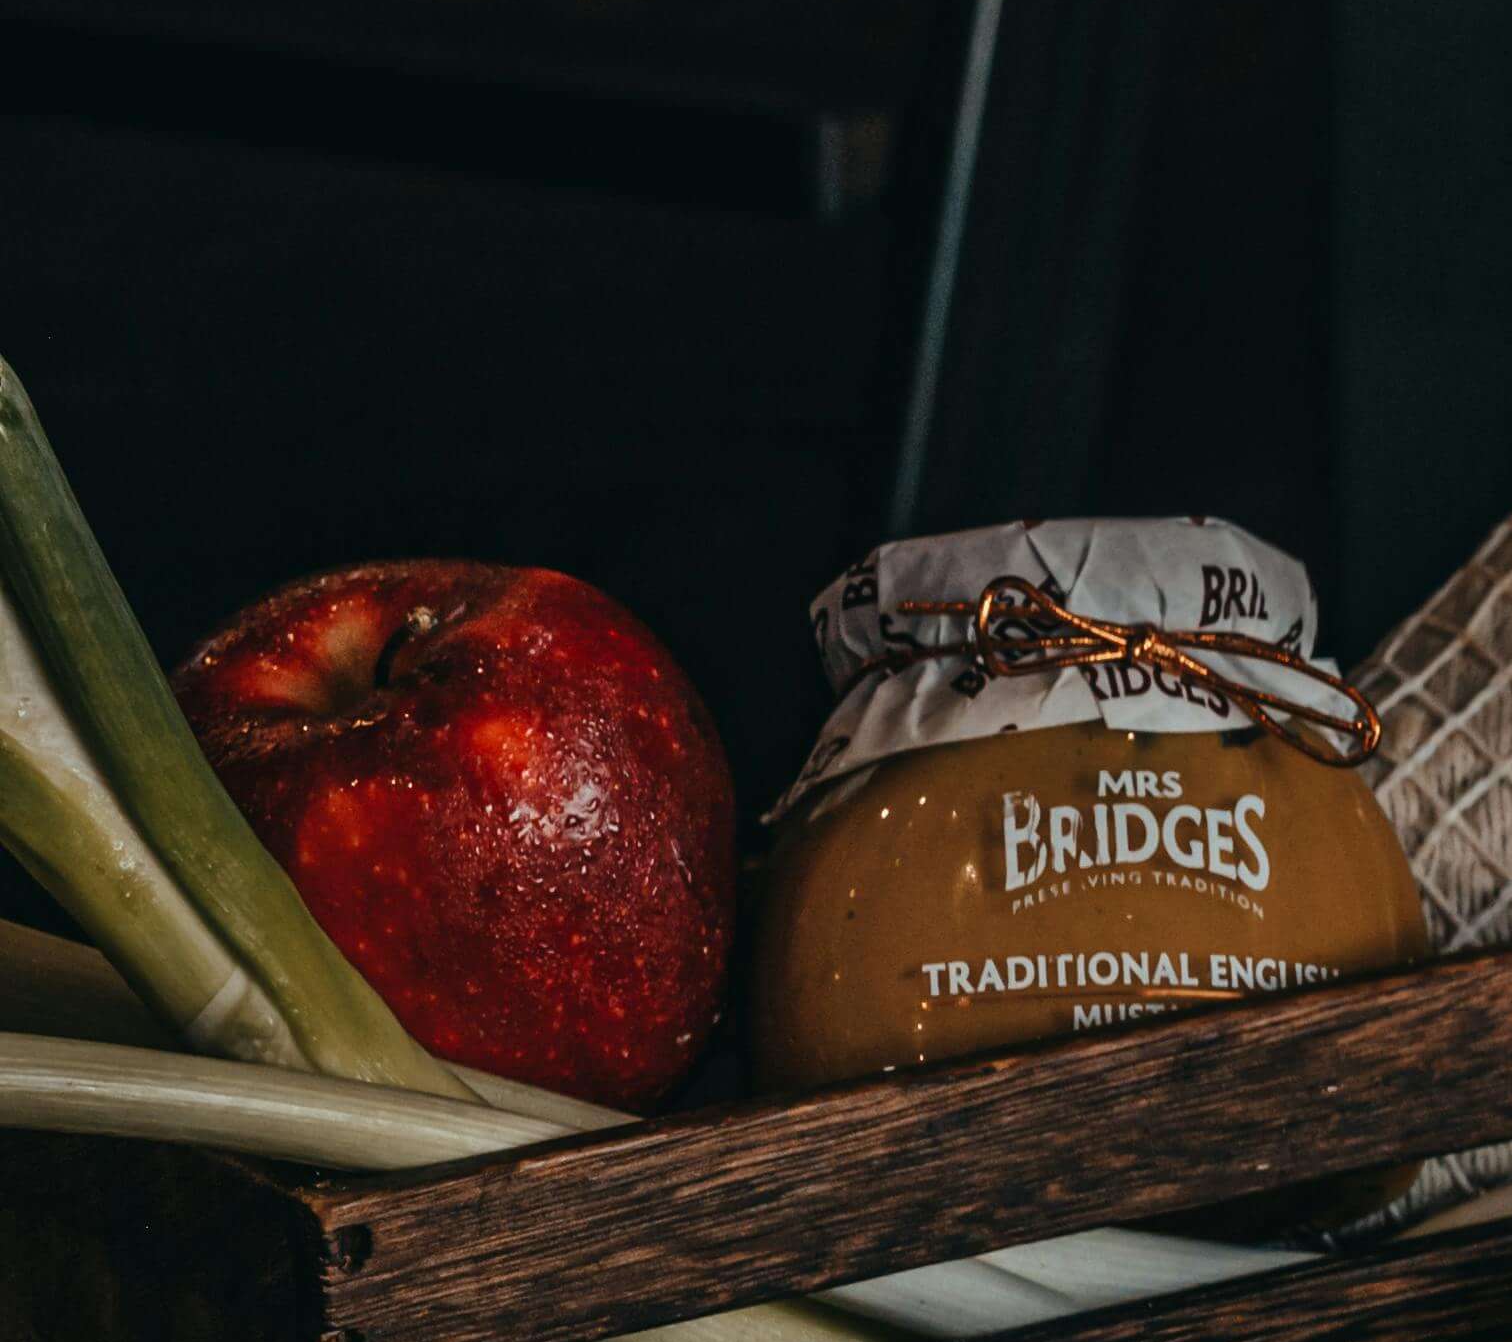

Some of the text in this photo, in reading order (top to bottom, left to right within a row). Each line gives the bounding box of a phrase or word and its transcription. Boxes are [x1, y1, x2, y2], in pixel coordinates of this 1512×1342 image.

[1096, 769, 1183, 799] MRS
[1001, 791, 1271, 893] BRIDGES
[1011, 870, 1265, 922] PRESEVING TRADITION
[920, 951, 1202, 997] TRADITIONAL
